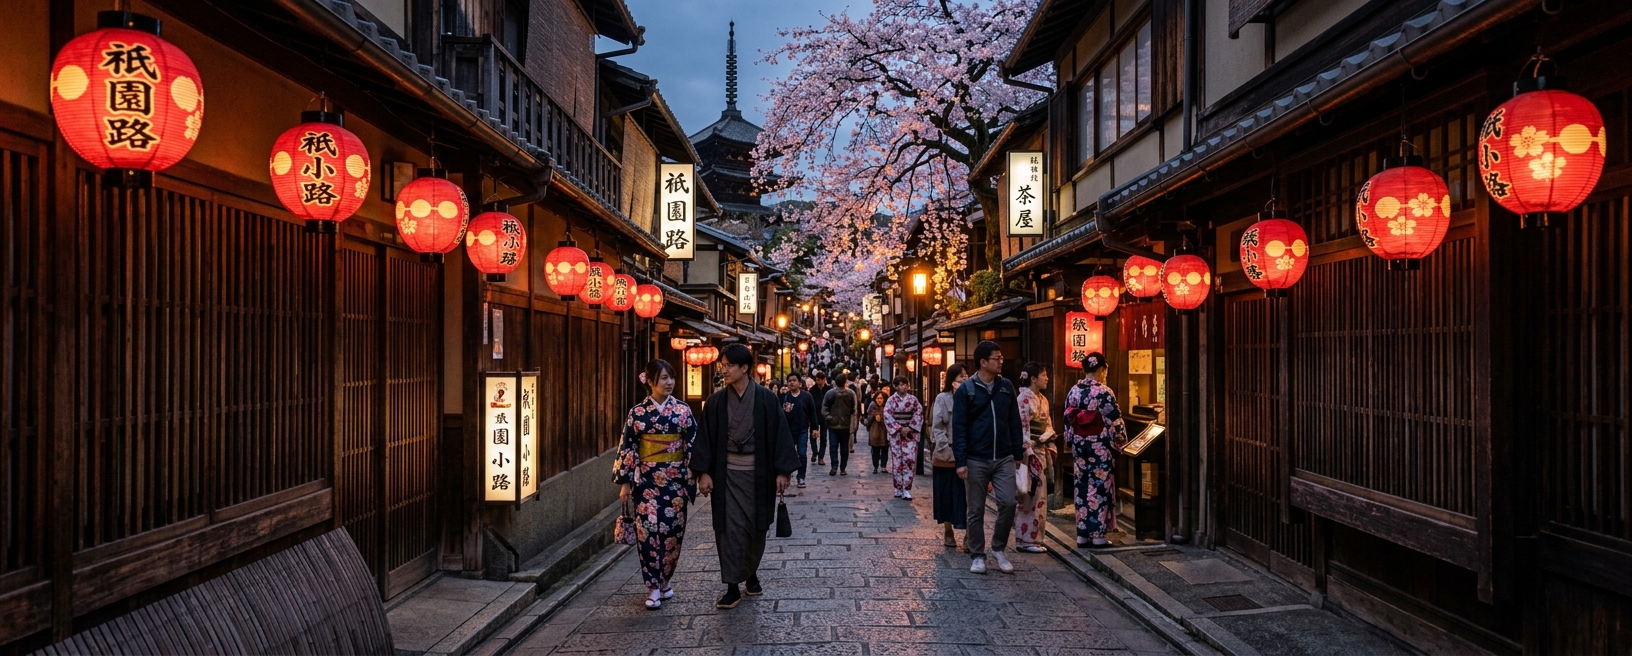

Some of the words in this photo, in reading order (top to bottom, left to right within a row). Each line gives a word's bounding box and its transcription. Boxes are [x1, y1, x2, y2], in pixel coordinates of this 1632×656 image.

[101, 43, 159, 149] 祇園路
[299, 132, 338, 205] 祇小路
[664, 172, 690, 250] 祇園路
[1015, 184, 1036, 229] 茶屋
